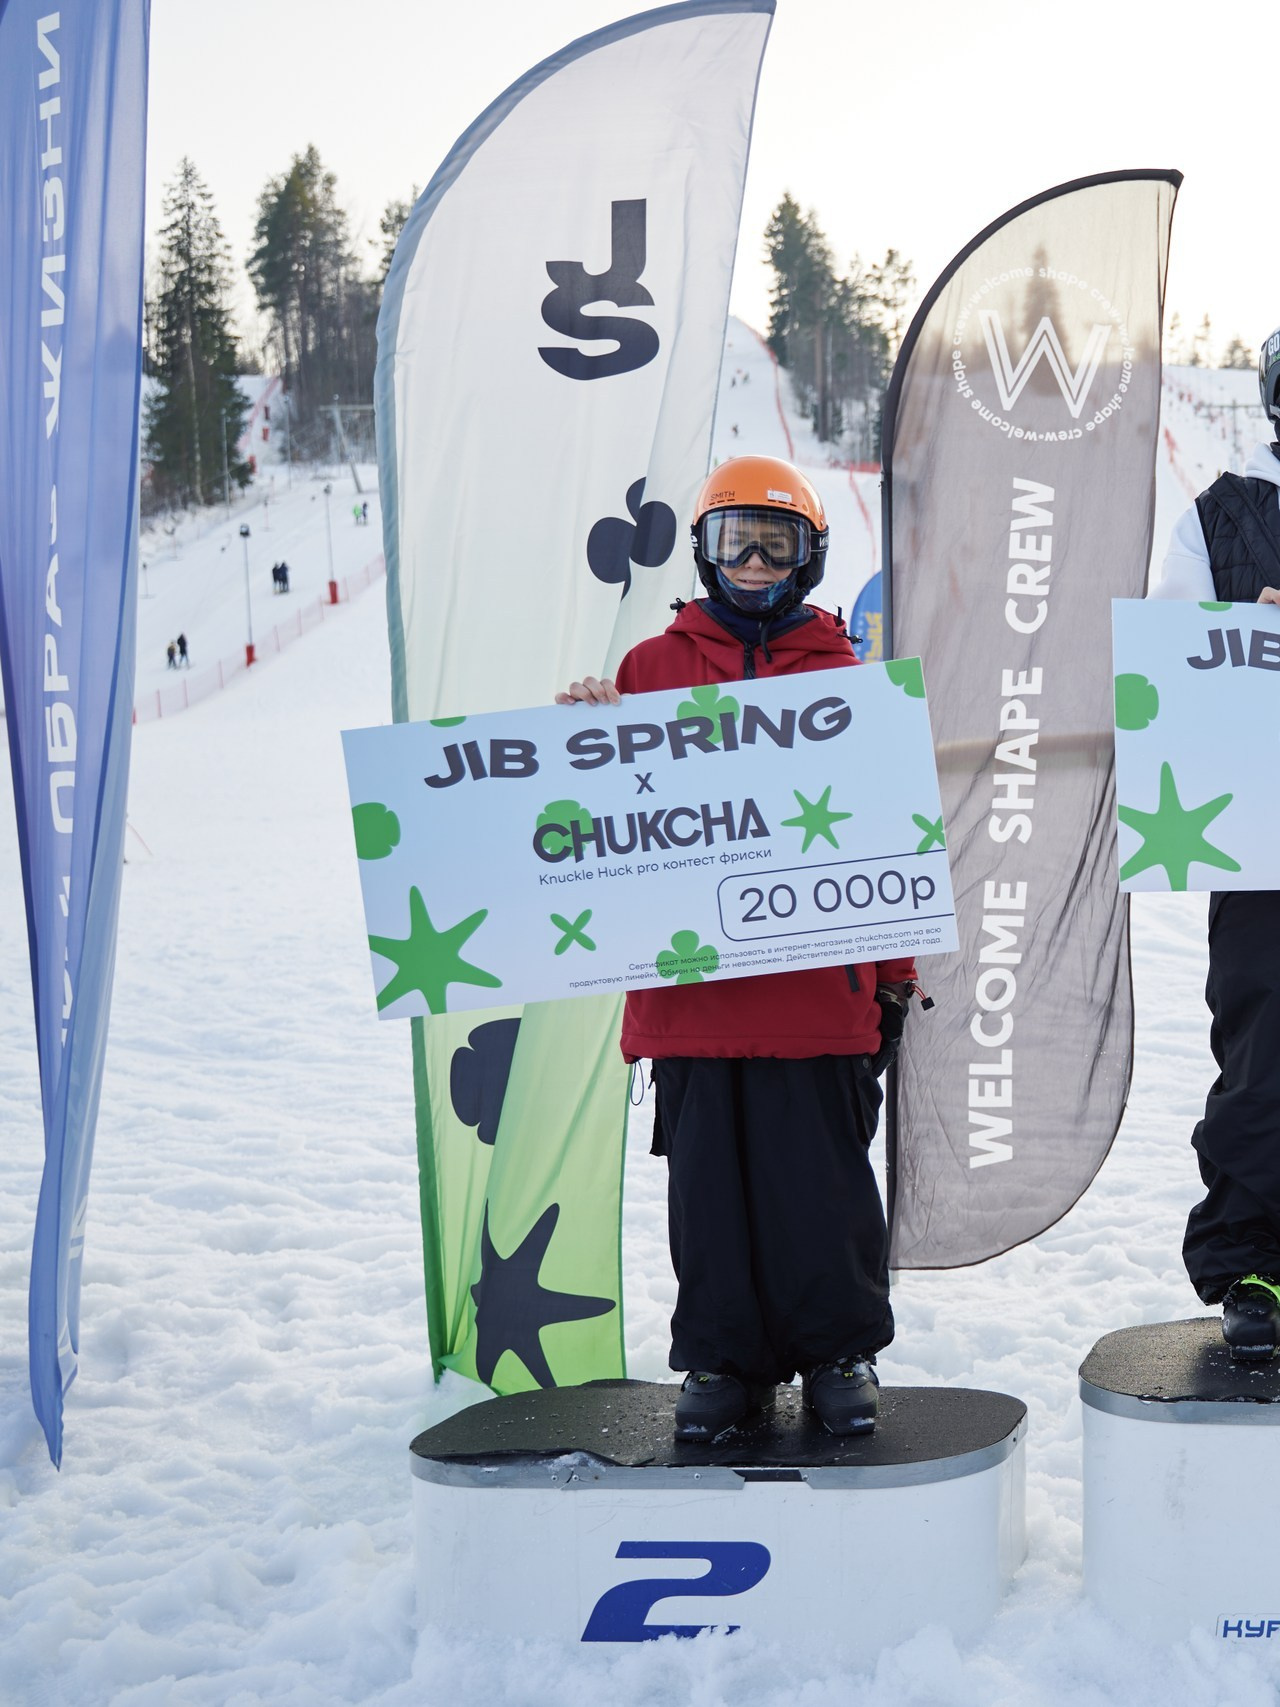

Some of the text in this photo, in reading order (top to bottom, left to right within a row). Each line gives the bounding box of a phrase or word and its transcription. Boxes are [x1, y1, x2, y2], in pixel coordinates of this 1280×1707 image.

[36, 11, 66, 440] ЖИЗНИ
[970, 266, 1122, 318] welcome shape crew
[952, 309, 1038, 442] welcome shape crew
[1044, 323, 1136, 442] welcome shape crew
[710, 491, 736, 502] SMITH
[424, 696, 851, 788] JIB SPRING
[532, 798, 770, 863] CHUKCHA
[969, 477, 1058, 1170] WELCOME SHAPE CREW
[538, 847, 772, 886] Knuckle Huck pro контест фриски
[739, 884, 796, 922] 20
[569, 975, 623, 989] продуктовую
[701, 962, 730, 972] деньги
[785, 946, 843, 962] Действителен
[844, 947, 855, 955] до
[856, 944, 865, 953] 31
[866, 941, 898, 952] августа
[899, 937, 921, 947] 2024
[628, 957, 679, 973] Сертификат
[680, 955, 708, 965] можно
[710, 948, 765, 961] использовать
[773, 938, 853, 955] интернет-магазине
[854, 929, 912, 943] chukchas.com
[925, 927, 942, 935] всю
[580, 1541, 772, 1644] 2
